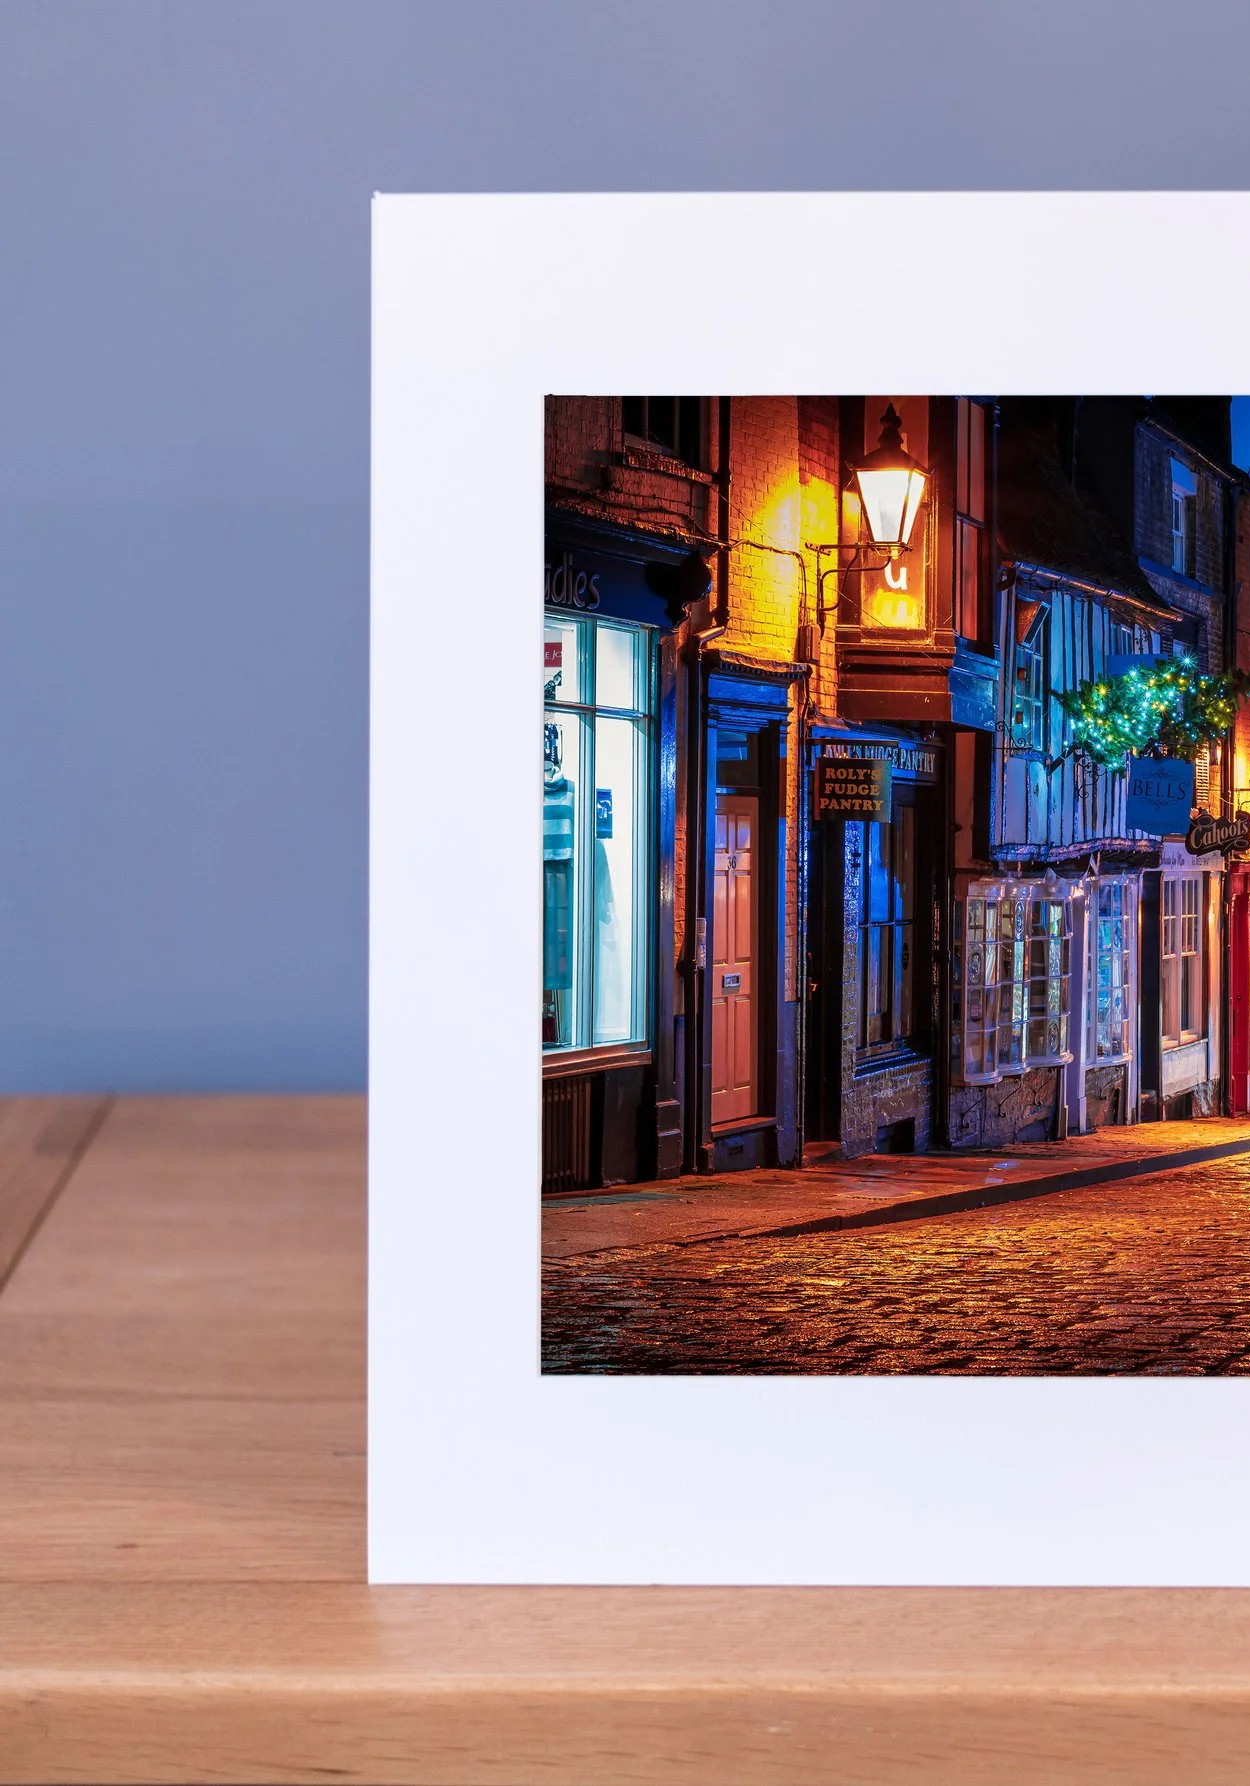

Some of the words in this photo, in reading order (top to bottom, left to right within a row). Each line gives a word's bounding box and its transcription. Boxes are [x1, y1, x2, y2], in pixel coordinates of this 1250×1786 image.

[899, 748, 936, 773] PANTRY
[825, 767, 882, 780] ROLY'S
[824, 783, 881, 796] FUDGE
[819, 798, 885, 811] PANTRY
[1190, 819, 1249, 849] Cahoots
[727, 855, 737, 870] 36
